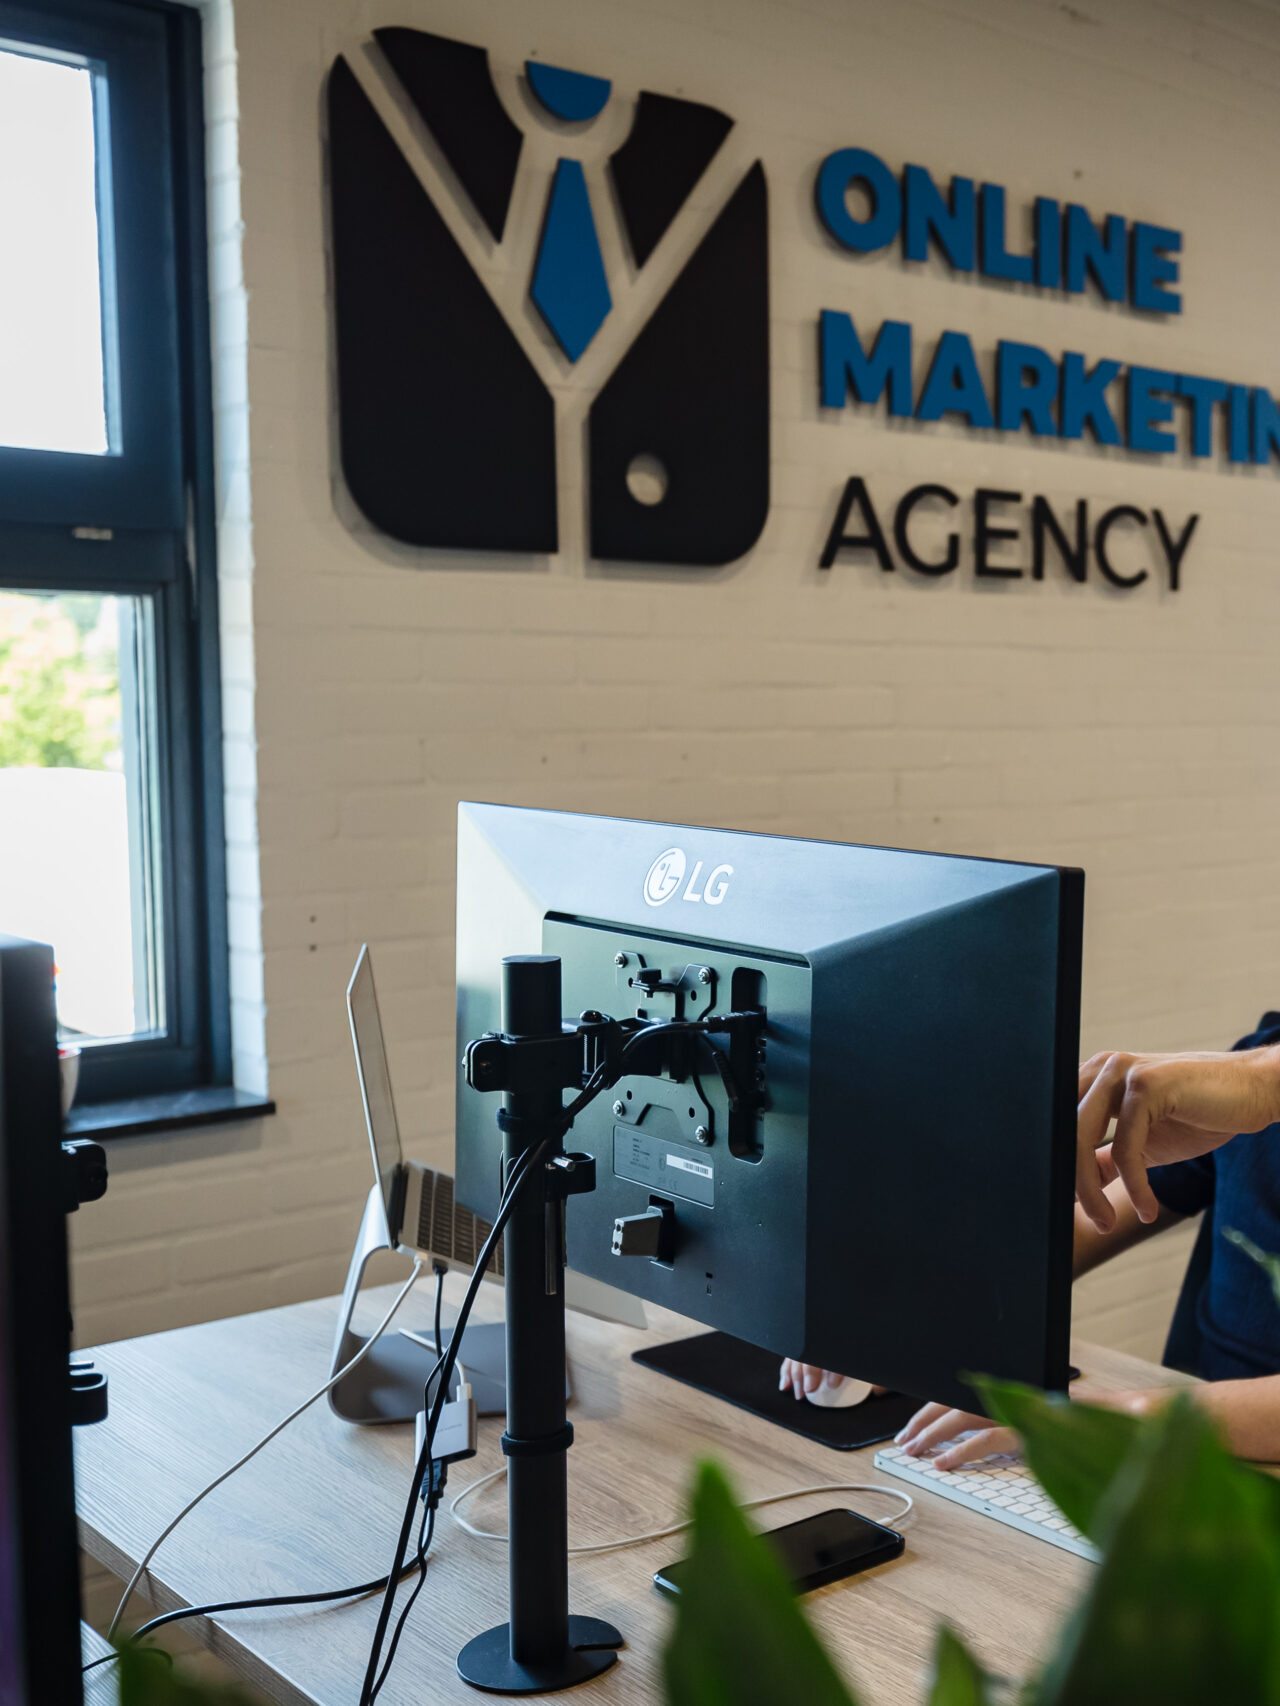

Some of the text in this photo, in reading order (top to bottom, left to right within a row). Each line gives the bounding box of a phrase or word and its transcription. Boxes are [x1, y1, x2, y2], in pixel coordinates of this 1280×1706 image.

[815, 147, 1183, 314] ONLINE
[818, 476, 1200, 592] AGENCY
[682, 860, 734, 905] LG
